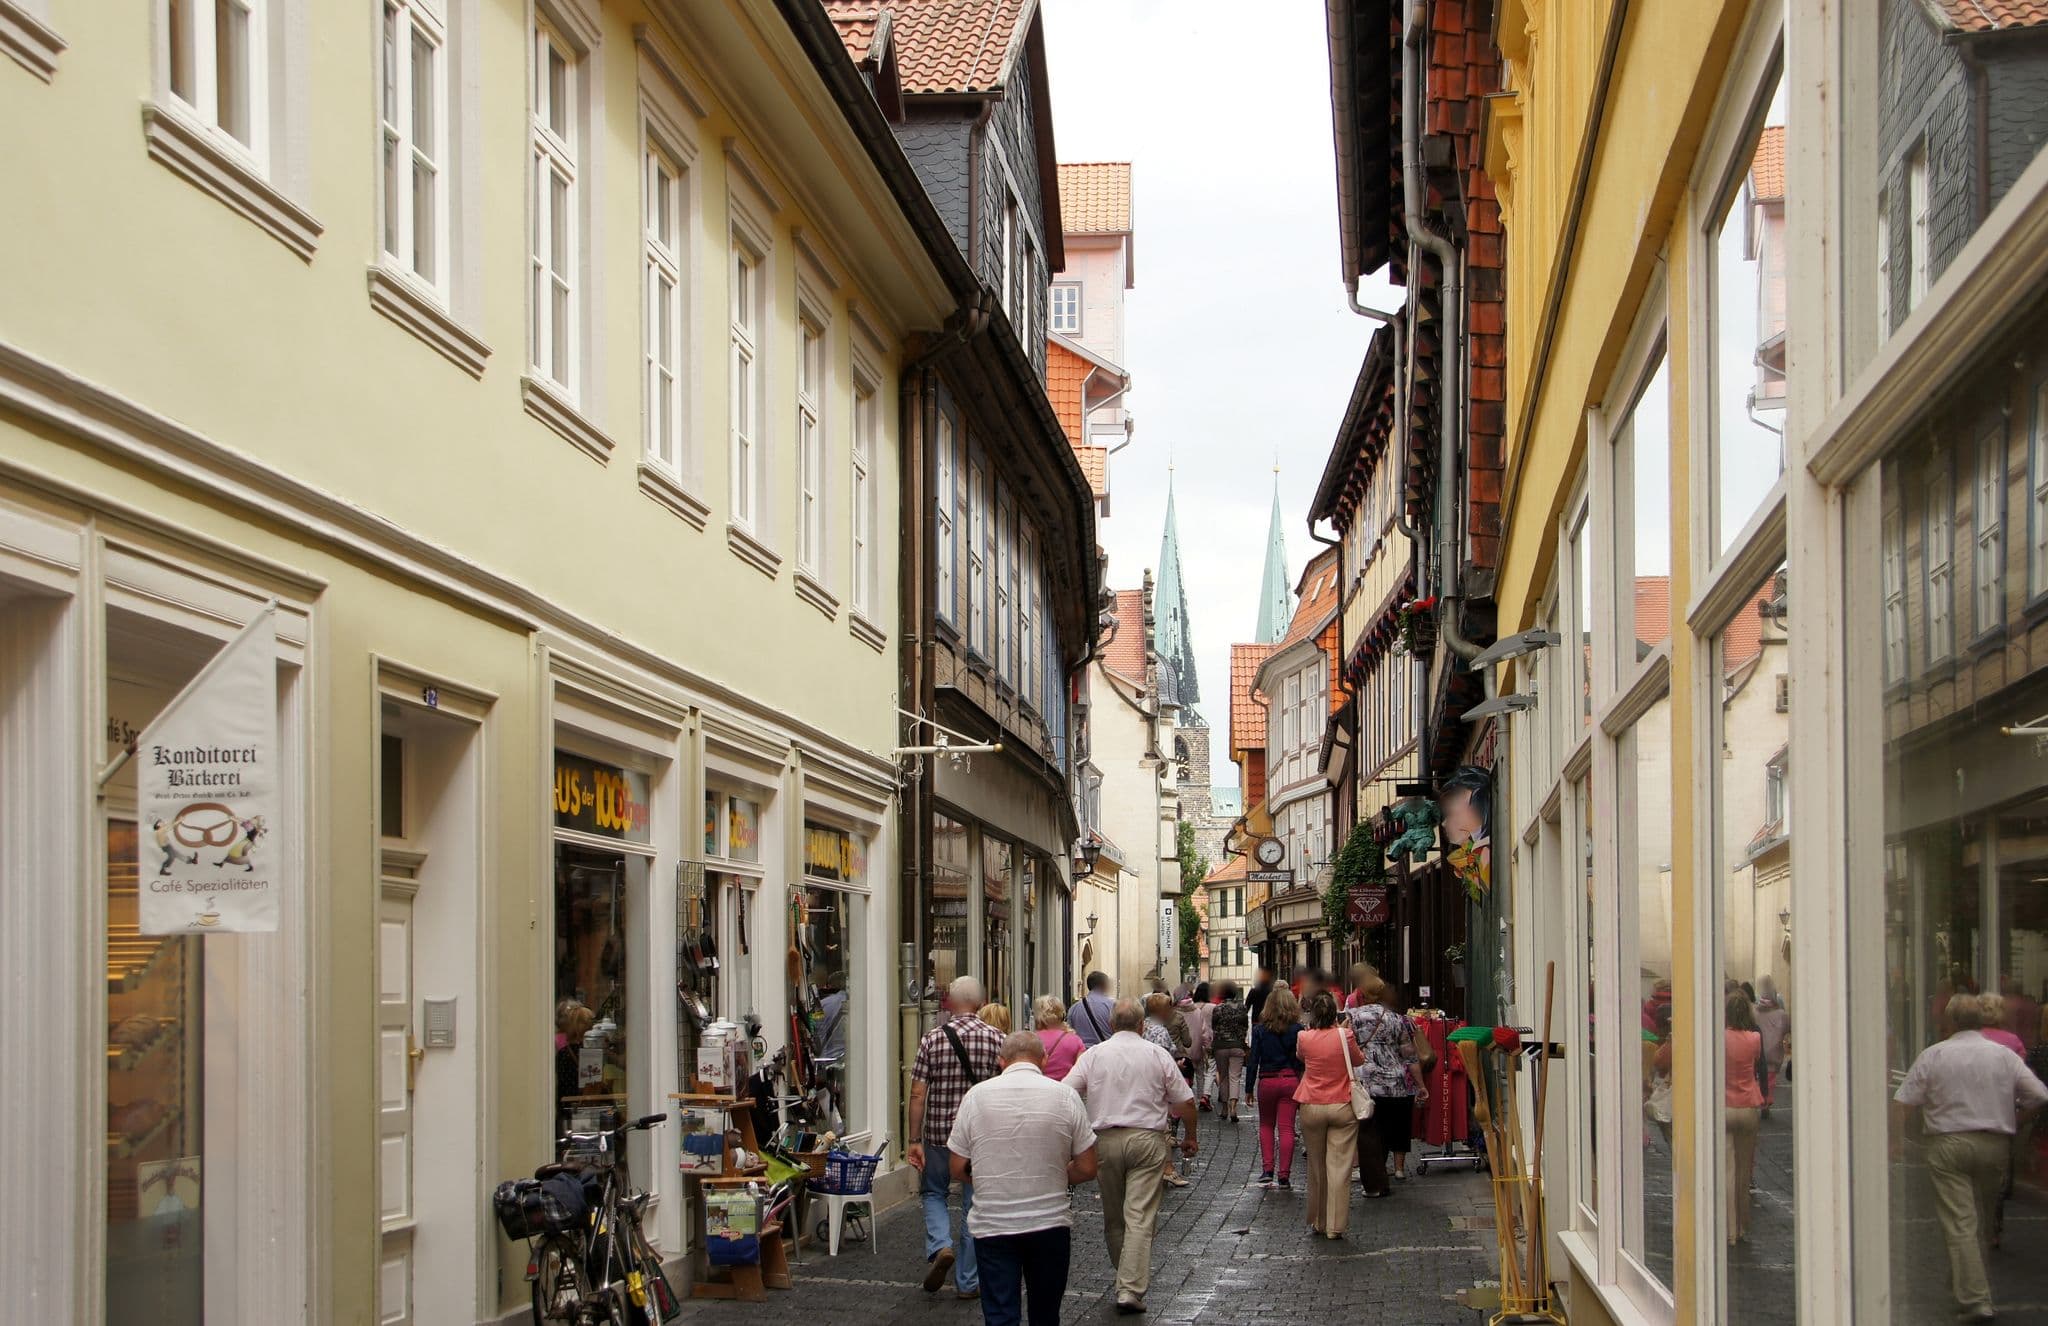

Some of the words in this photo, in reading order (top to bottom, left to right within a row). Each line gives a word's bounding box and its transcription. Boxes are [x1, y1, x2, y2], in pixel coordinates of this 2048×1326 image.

[153, 744, 256, 766] Konditorei
[168, 768, 241, 787] Bäckerei
[150, 880, 182, 893] Café
[186, 879, 269, 894] Spezialitäten
[1350, 913, 1385, 922] KARAT
